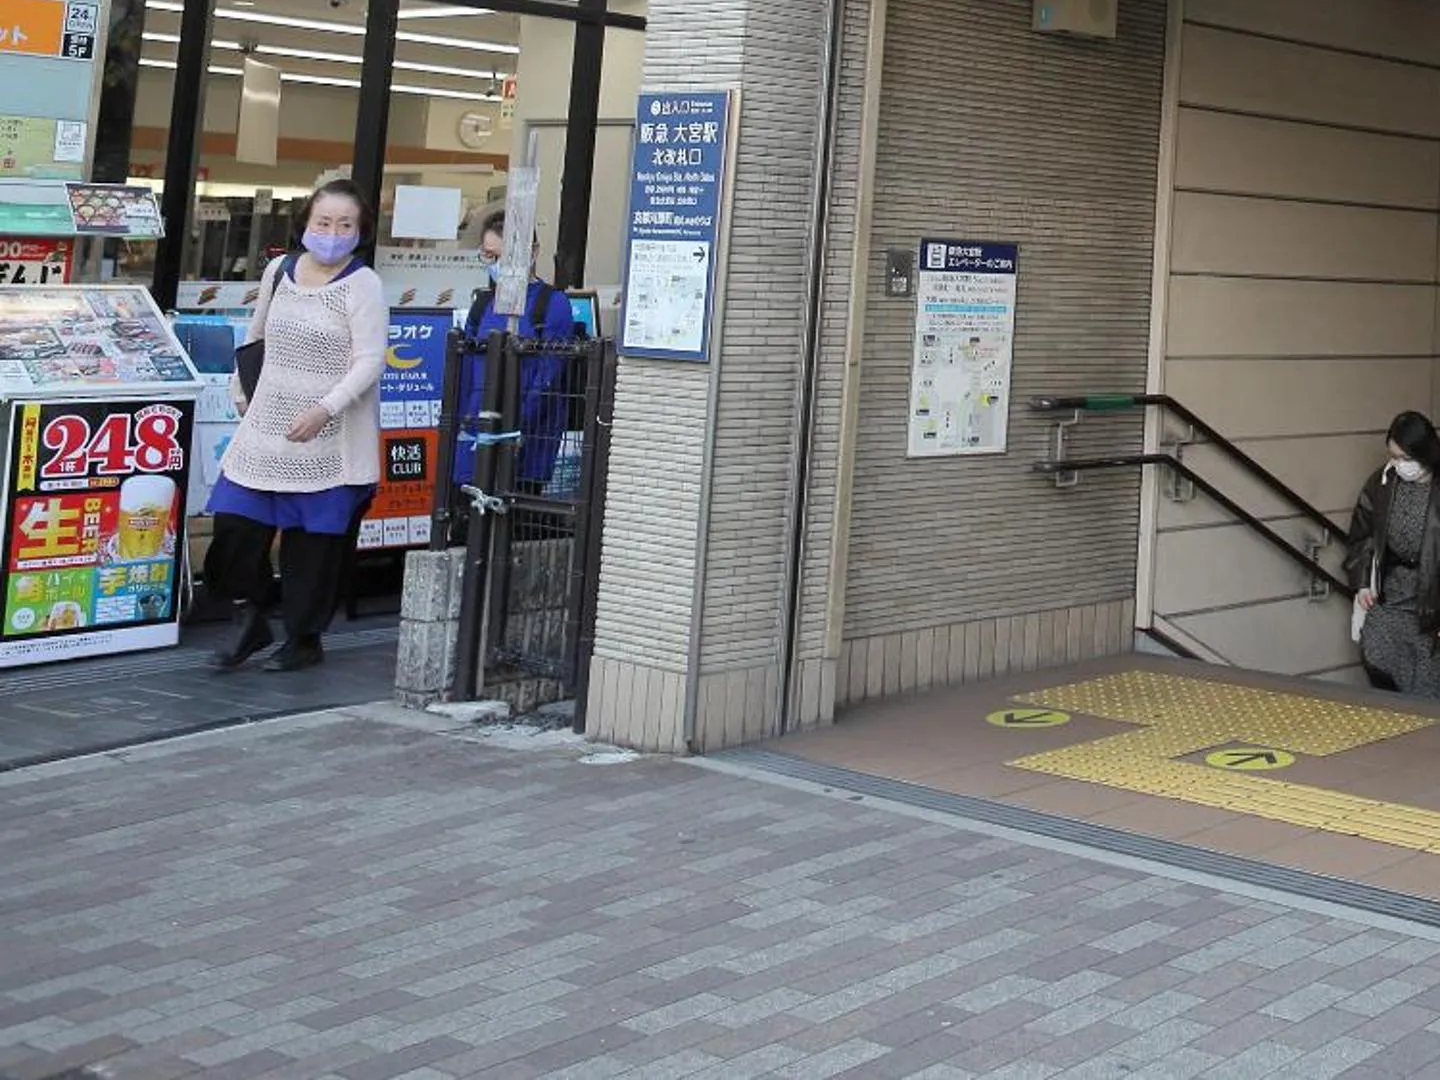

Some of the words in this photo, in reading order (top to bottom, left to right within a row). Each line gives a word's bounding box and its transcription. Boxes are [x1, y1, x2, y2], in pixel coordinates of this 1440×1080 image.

[640, 122, 669, 144] 阪急
[673, 121, 719, 144] 大宮駅
[41, 413, 180, 477] 248
[391, 443, 422, 461] 快活
[391, 462, 422, 475] CLUB
[19, 498, 81, 560] 生
[82, 497, 102, 553] BEER
